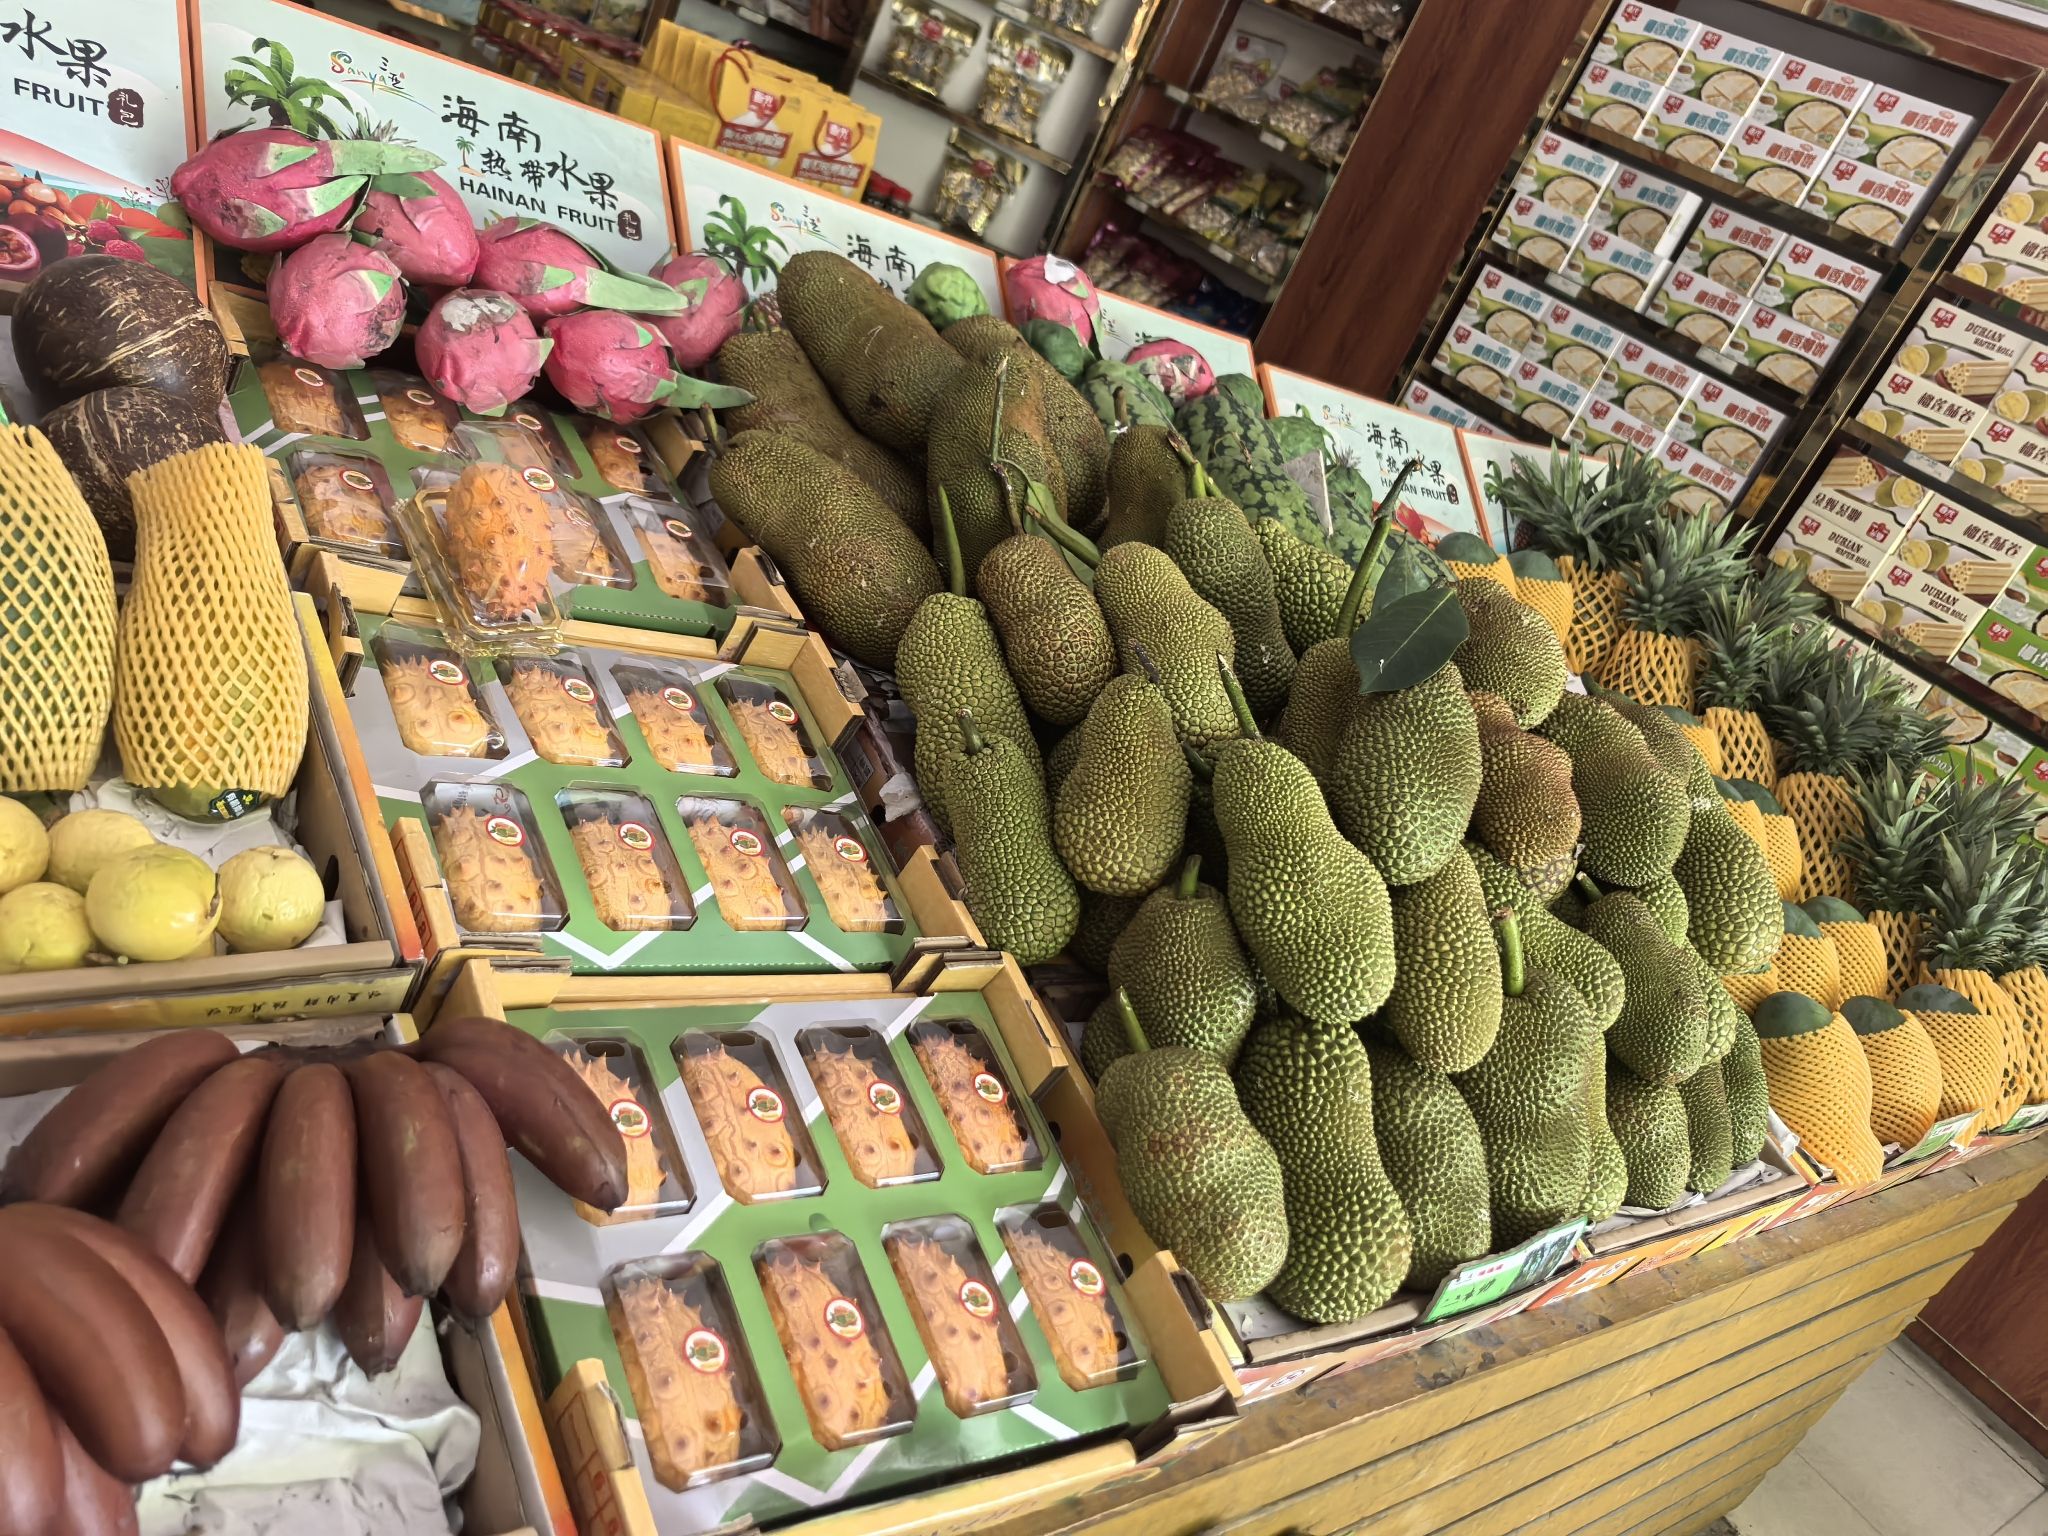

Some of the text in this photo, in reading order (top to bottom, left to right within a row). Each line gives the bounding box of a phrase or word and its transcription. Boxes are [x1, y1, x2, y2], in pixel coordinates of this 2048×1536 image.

[0, 8, 111, 88] 水果
[331, 50, 387, 96] Sanya
[14, 77, 104, 116] FRUIT
[441, 94, 541, 153] 海南
[459, 176, 616, 233] HAINAN FRUIT
[847, 234, 916, 282] 海南
[1367, 421, 1408, 455] 海南
[1421, 486, 1447, 501] FRUIT
[1828, 531, 1863, 553] DURIAN
[1920, 583, 1960, 607] DURIAN
